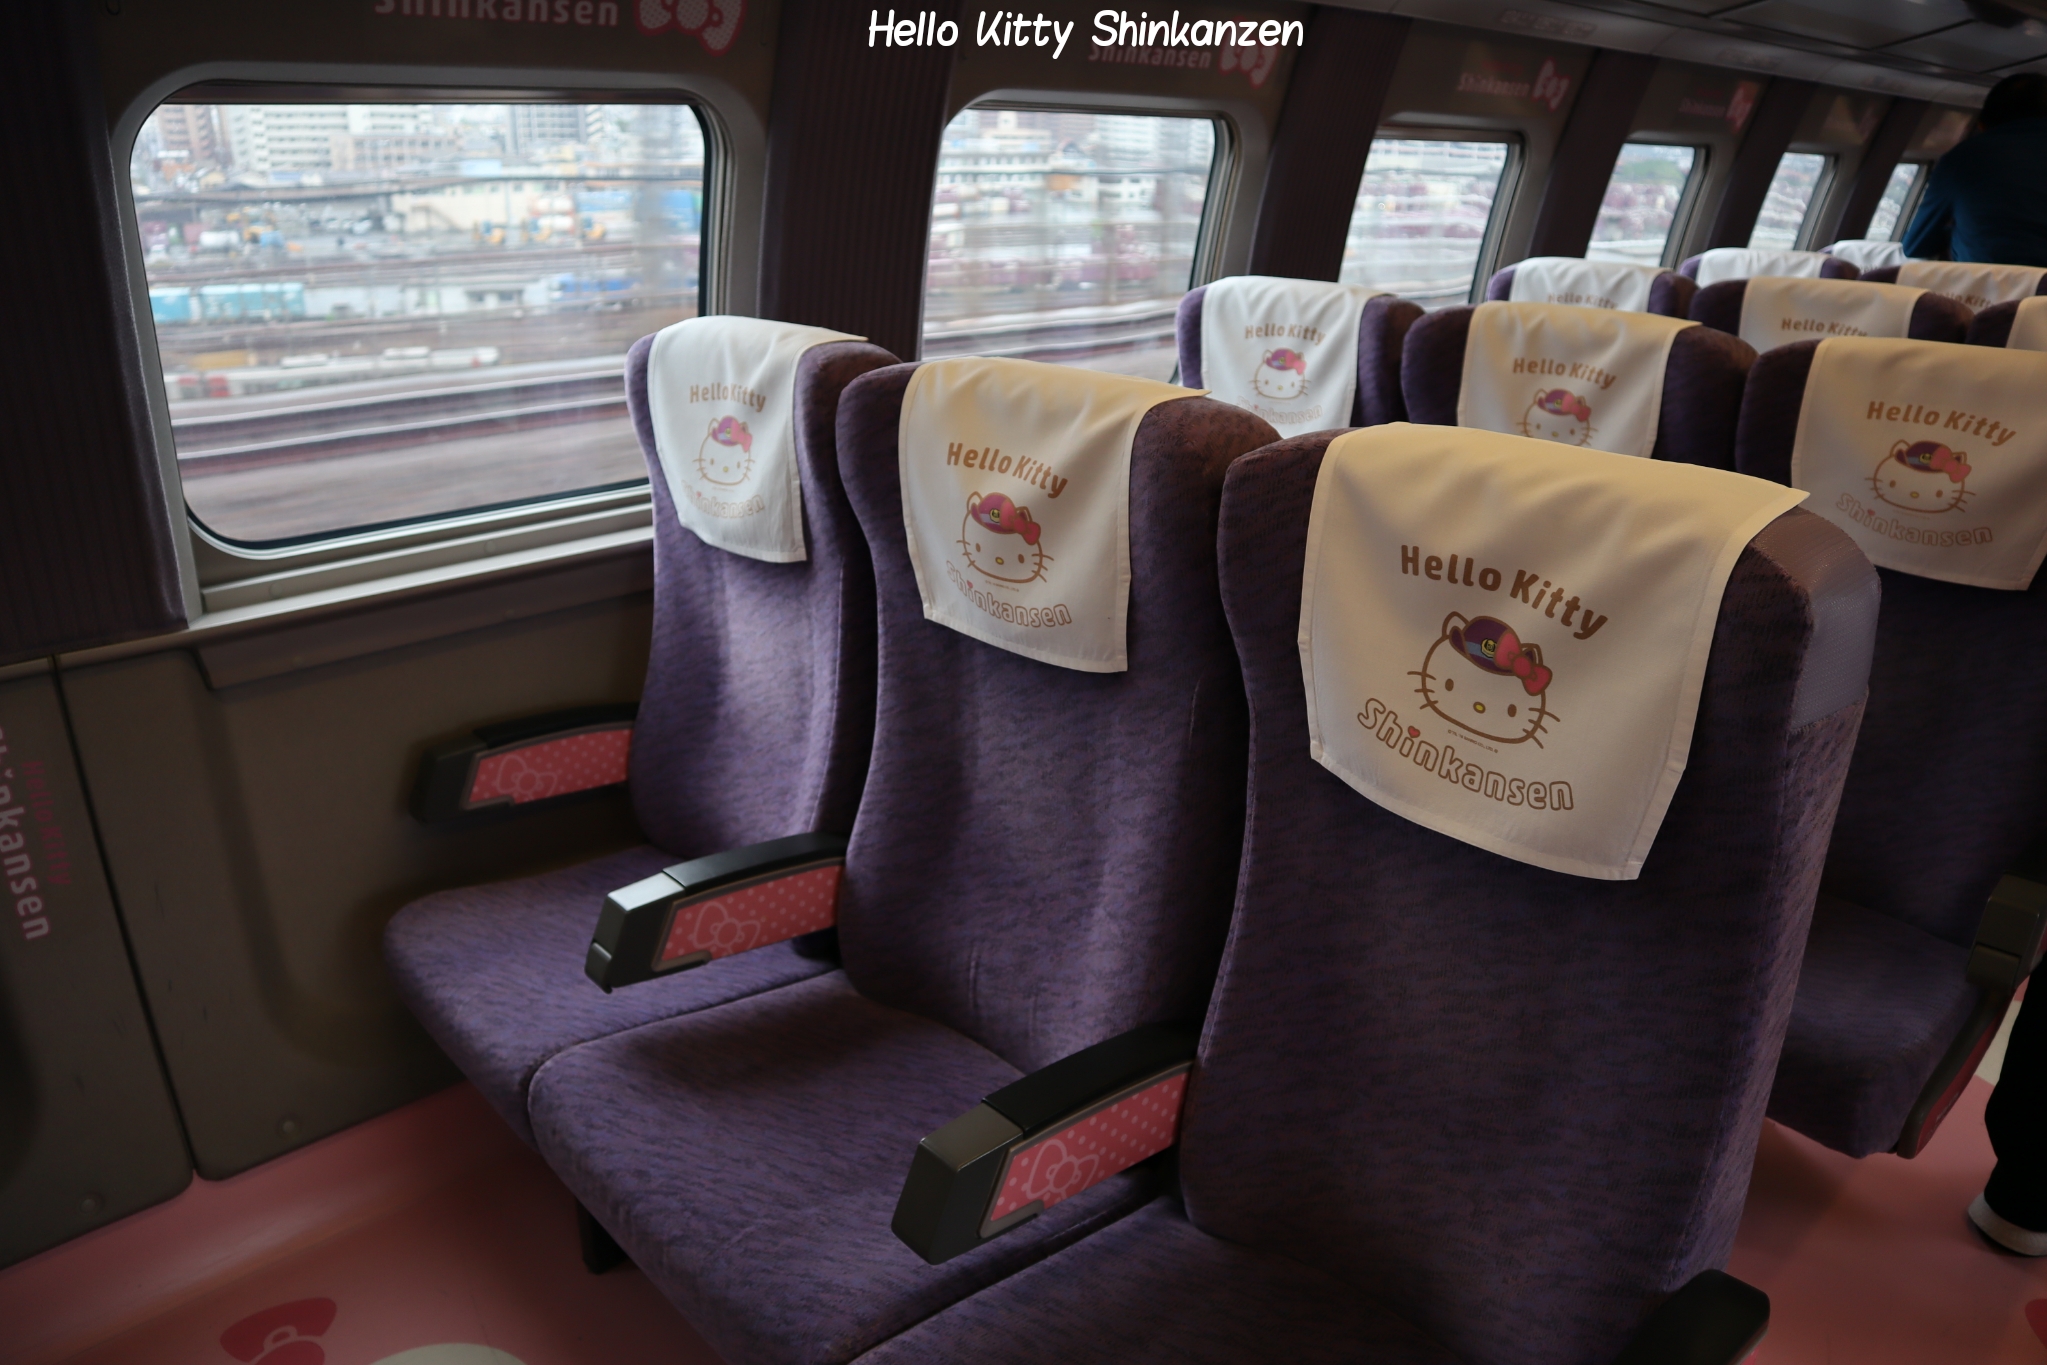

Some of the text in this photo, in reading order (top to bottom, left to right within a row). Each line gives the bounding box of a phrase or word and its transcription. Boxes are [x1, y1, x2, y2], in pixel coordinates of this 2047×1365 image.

[1244, 323, 1326, 346] Hello Kitty
[1781, 318, 1825, 332] Hello
[690, 382, 767, 413] Hello Kitty
[1513, 358, 1617, 390] Hello Kitty
[1866, 401, 2017, 447] Hello Kitty
[946, 442, 1068, 499] Hello Kitty
[1836, 492, 1993, 547] Shinkansen
[946, 560, 1072, 628] Shinkansen
[1401, 544, 1608, 640] Hello Kitty
[1357, 697, 1574, 811] Shinkansen
[21, 760, 72, 886] Hello Kitty
